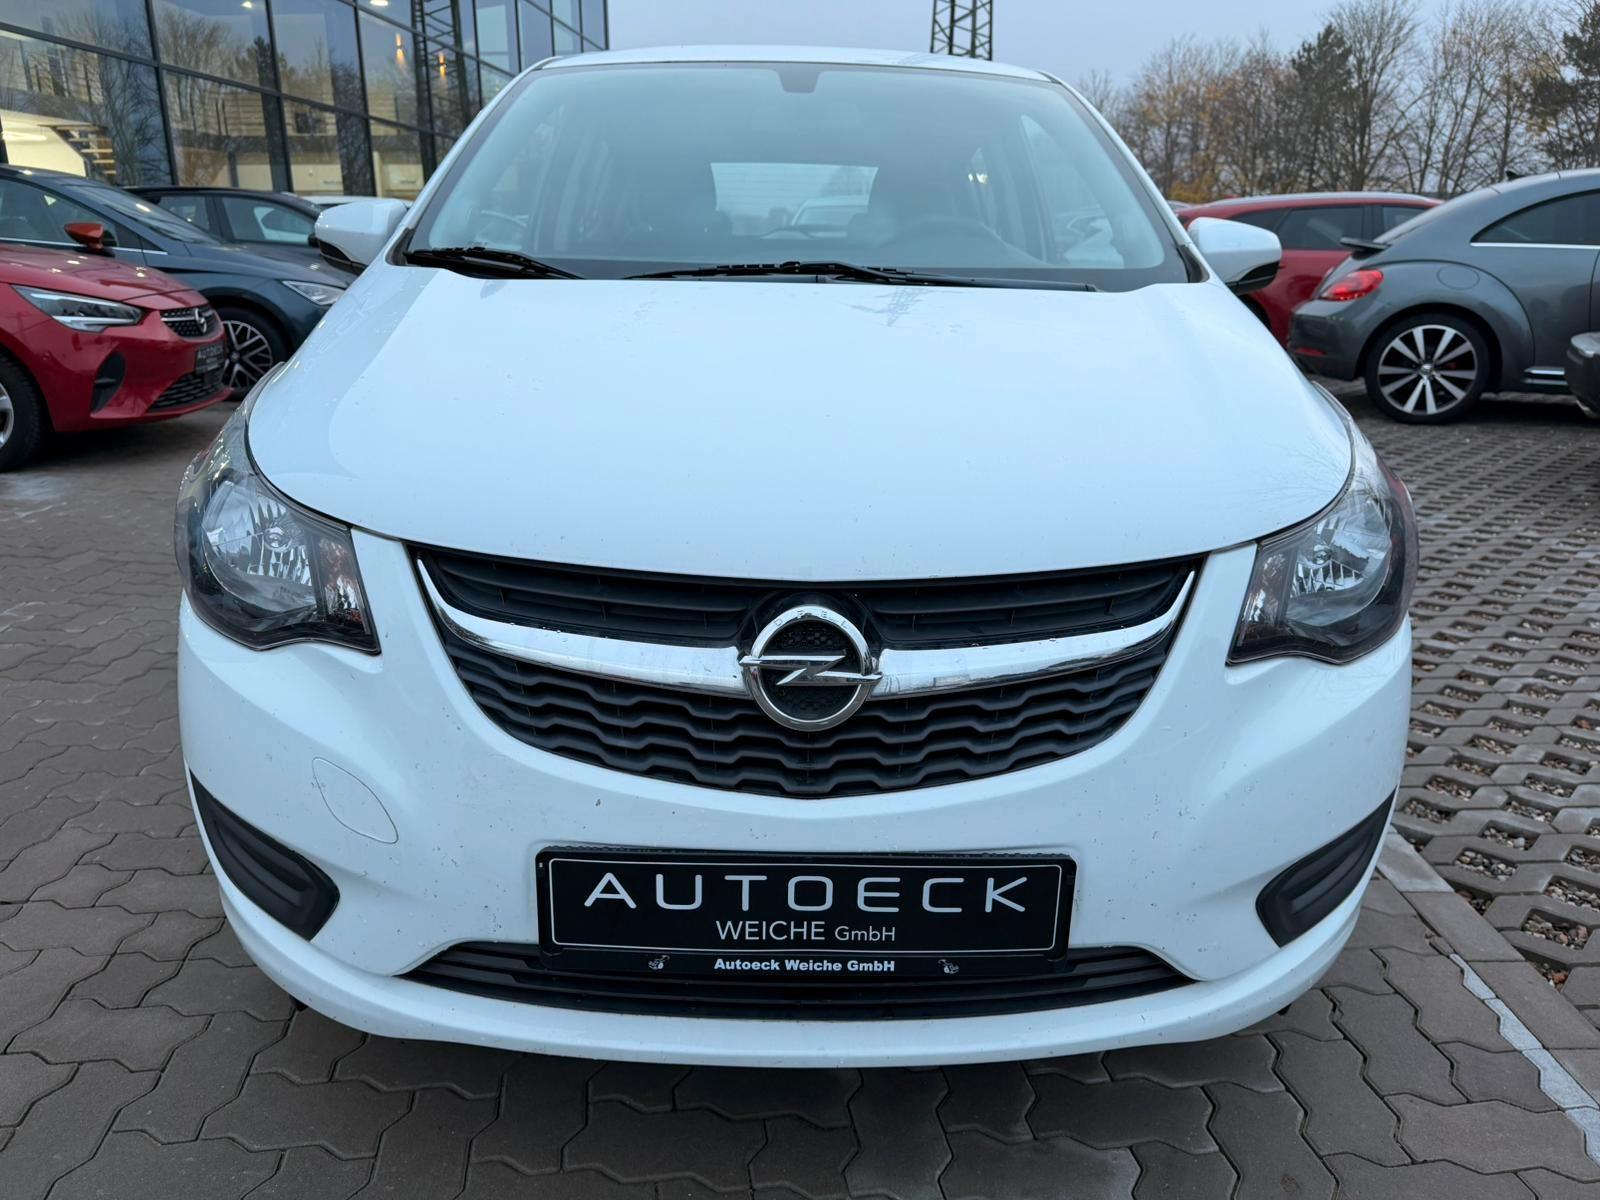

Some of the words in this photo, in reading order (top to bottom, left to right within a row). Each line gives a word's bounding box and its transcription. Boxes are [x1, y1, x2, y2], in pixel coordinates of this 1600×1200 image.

[583, 871, 1028, 913] AUTOECK
[715, 920, 826, 941] WEICHE
[834, 925, 896, 942] GmbH
[713, 958, 781, 971] Autoeck
[784, 959, 843, 972] Weiche
[846, 959, 896, 972] GmbH
